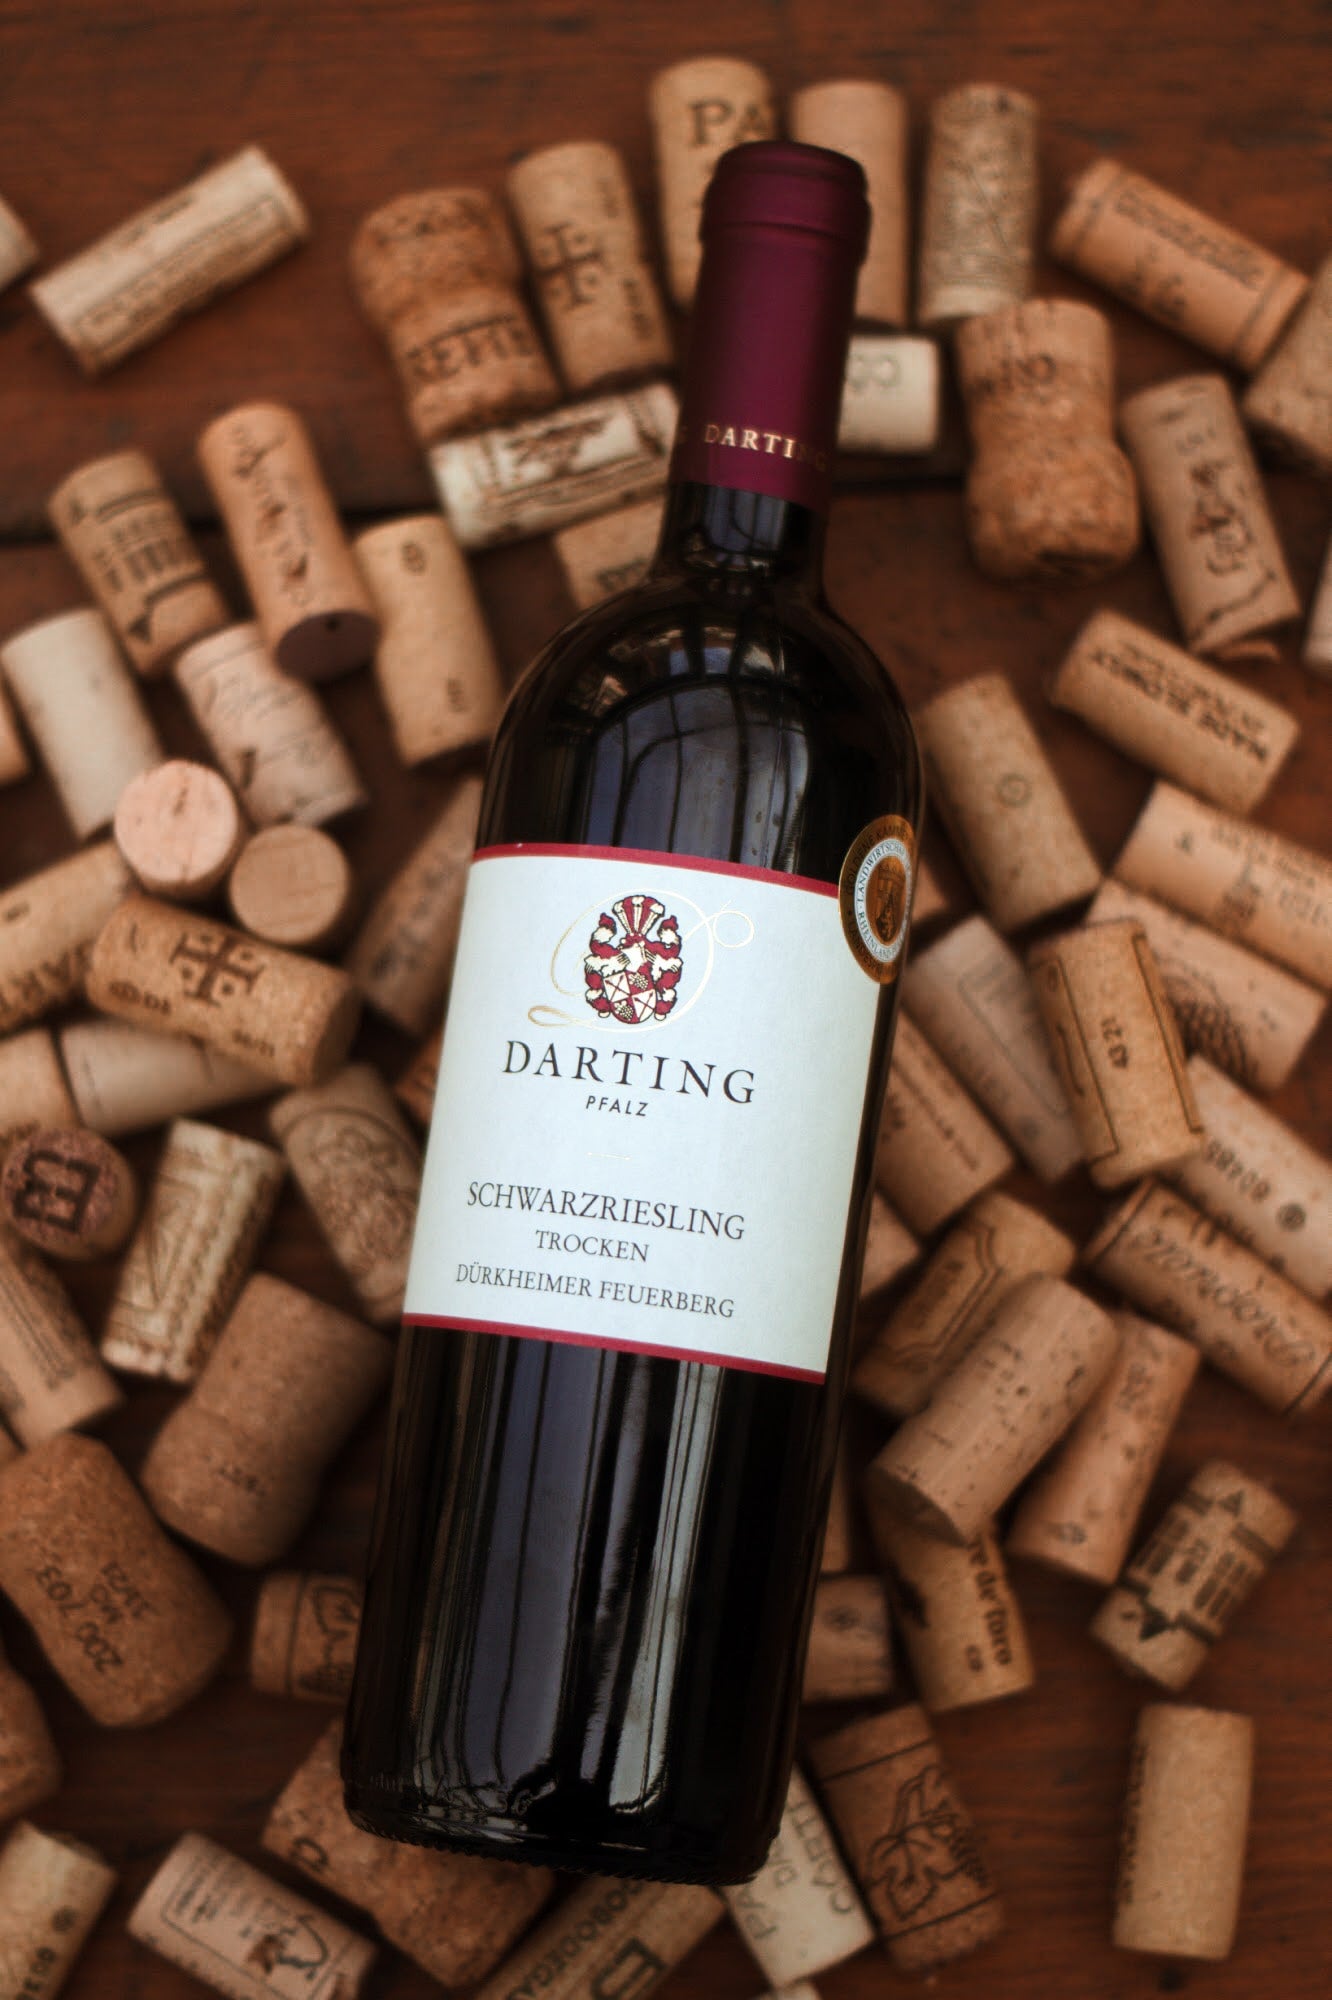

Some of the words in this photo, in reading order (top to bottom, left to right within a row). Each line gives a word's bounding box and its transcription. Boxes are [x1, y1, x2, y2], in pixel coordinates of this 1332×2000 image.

[503, 1041, 754, 1104] DARTING
[586, 1096, 648, 1117] PFALZ
[468, 1182, 744, 1240] SCHWARZRIESLING
[536, 1229, 650, 1263] TROCKEN
[456, 1262, 591, 1297] DÜRKHEIMER
[599, 1281, 734, 1318] FEUERBERG
